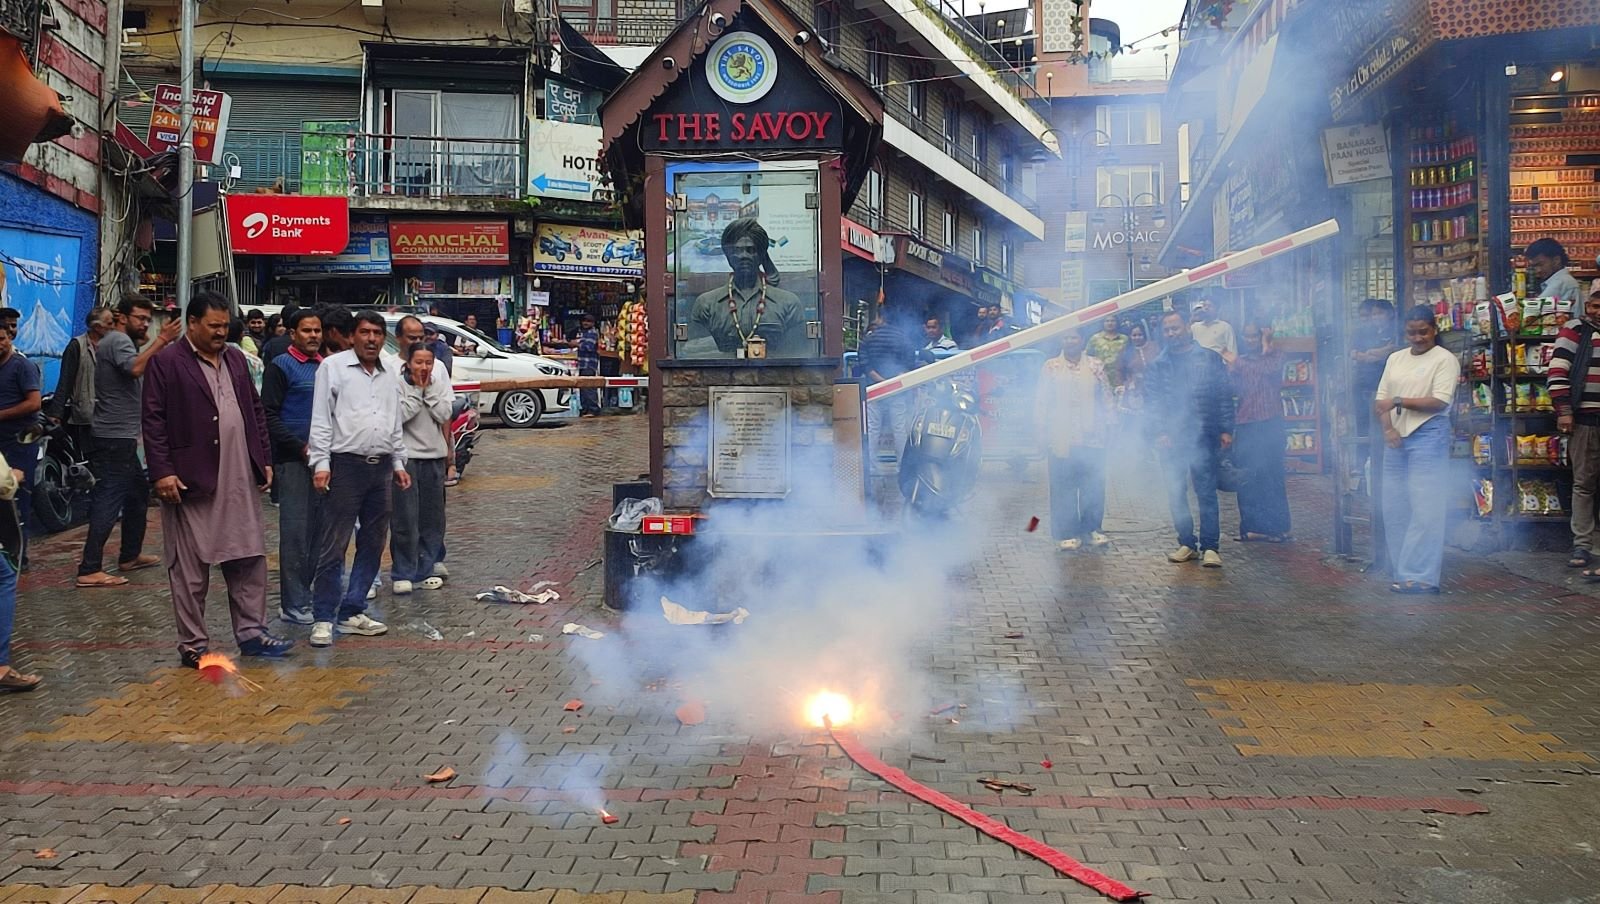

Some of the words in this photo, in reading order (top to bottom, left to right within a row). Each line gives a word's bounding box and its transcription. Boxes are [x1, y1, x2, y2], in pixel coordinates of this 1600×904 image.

[156, 114, 169, 124] 24
[653, 113, 721, 141] THE
[731, 111, 832, 141] SAVOY
[159, 132, 177, 141] VISA
[1336, 136, 1377, 151] BANARAS
[1330, 149, 1354, 161] PAAN
[1356, 144, 1386, 157] HOUSE
[272, 214, 331, 227] Payments
[272, 228, 303, 238] Bank
[578, 228, 609, 240] Avani
[395, 234, 504, 247] AANCHAL
[1093, 230, 1161, 251] MOSAIC
[401, 246, 498, 254] COMMUNICATION
